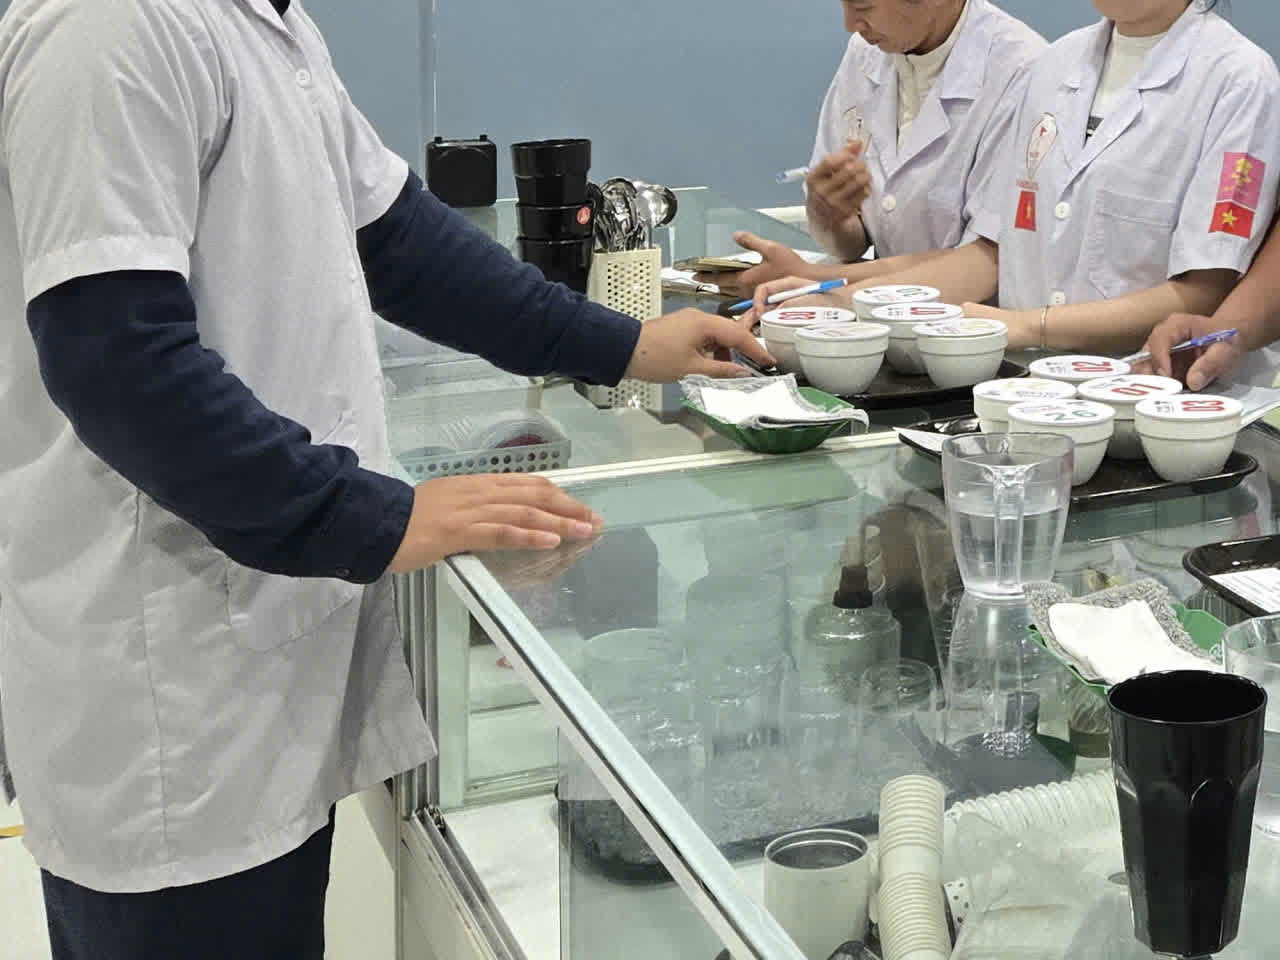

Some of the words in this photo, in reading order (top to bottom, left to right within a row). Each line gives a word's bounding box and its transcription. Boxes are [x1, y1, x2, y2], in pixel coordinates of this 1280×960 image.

[1072, 361, 1113, 373] 02
[1112, 383, 1165, 396] 01
[1181, 400, 1225, 412] 03
[1045, 409, 1099, 420] 26
